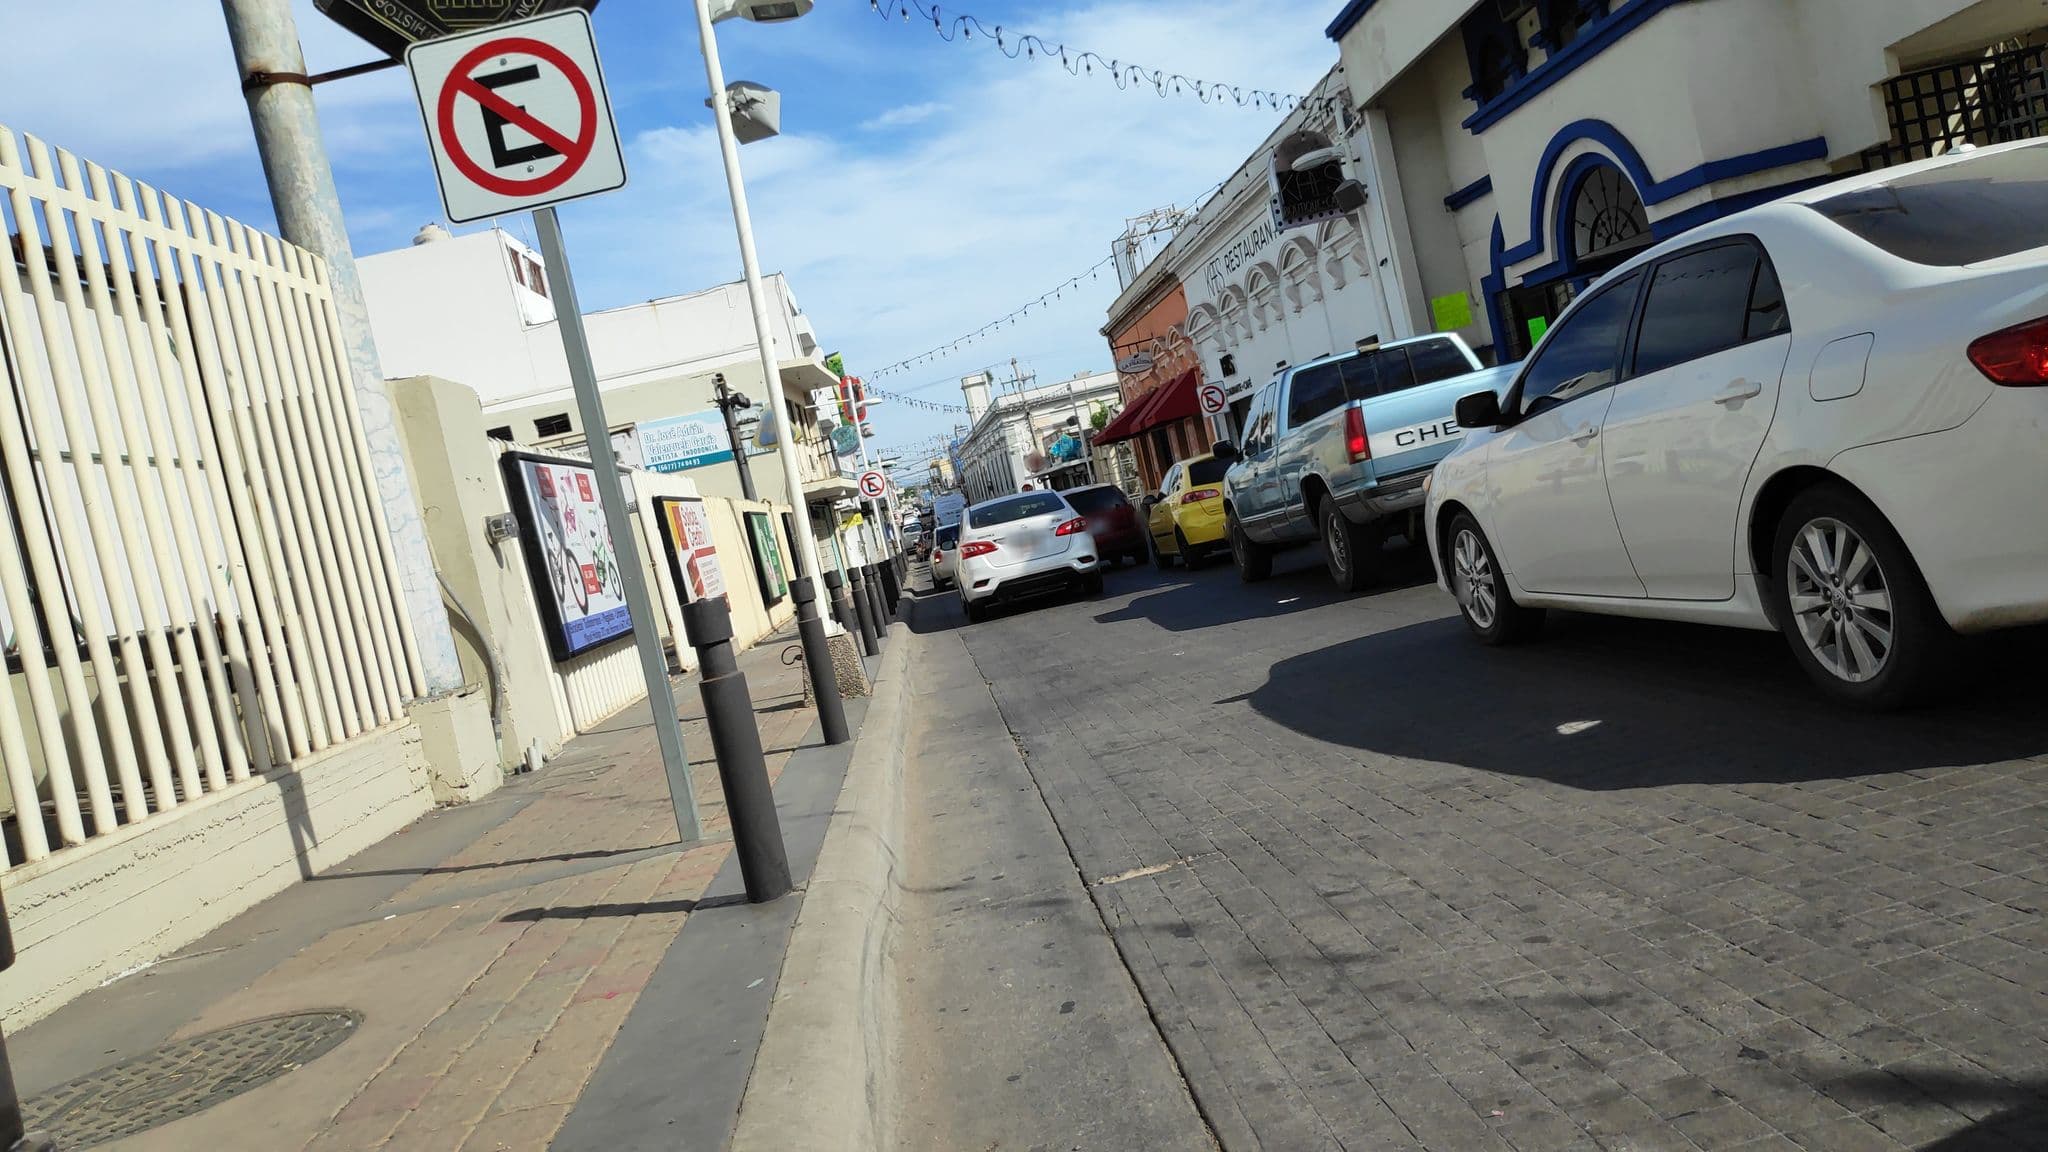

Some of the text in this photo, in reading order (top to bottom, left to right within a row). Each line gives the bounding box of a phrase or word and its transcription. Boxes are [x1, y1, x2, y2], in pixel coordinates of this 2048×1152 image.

[473, 64, 562, 168] E
[644, 431, 656, 444] Dr.
[650, 450, 678, 463] DENTISTA
